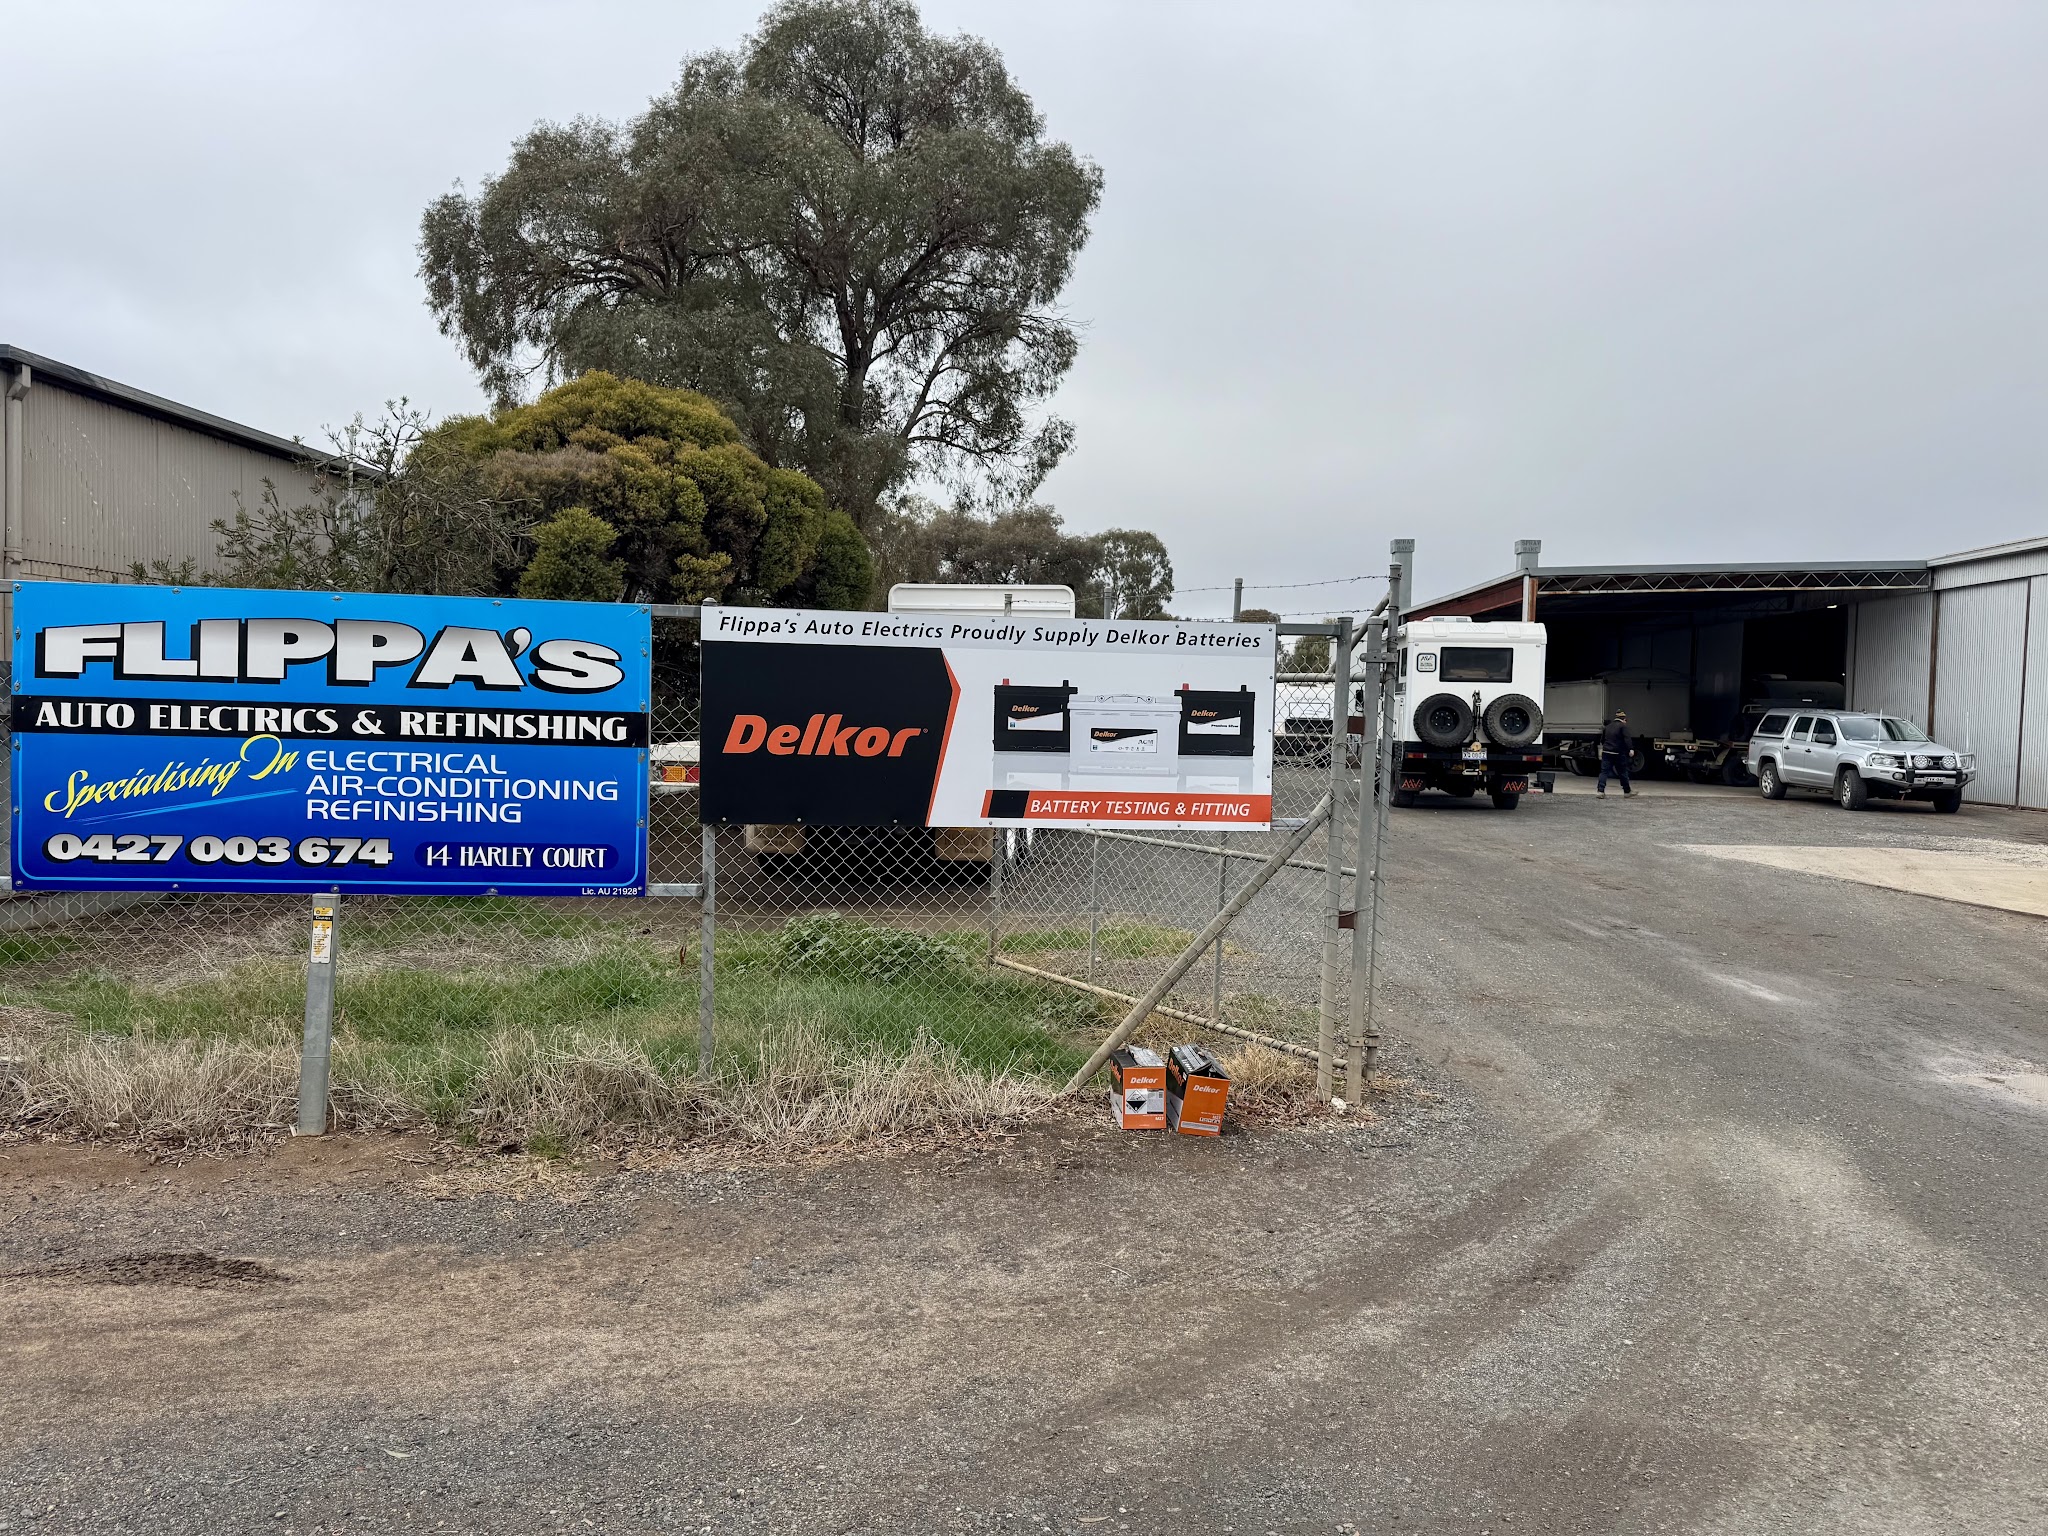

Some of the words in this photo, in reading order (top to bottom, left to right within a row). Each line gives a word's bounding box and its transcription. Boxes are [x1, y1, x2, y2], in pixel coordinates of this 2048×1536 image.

[720, 614, 798, 637] Flippa's
[804, 619, 854, 636] Auto
[861, 620, 944, 639] Electrics
[950, 624, 1027, 645] Proudly
[1032, 626, 1100, 647] Supply
[1106, 629, 1170, 645] Delkor
[1175, 631, 1261, 648] Batteries
[1011, 704, 1039, 713] Delkor
[1190, 709, 1218, 718] Delkor
[35, 702, 135, 729] AUTO
[150, 704, 339, 735] ELECTRICS
[352, 710, 386, 735] &
[400, 711, 628, 741] REFINISHING
[723, 713, 921, 757] Delkor
[306, 750, 507, 776] ELECTRICAL
[44, 752, 241, 818] Specialising
[306, 776, 618, 801] AIR-CONDITIONING
[307, 800, 522, 823] REFINISHING
[1030, 799, 1102, 814] BATTERY
[1105, 801, 1171, 815] TESTING
[1174, 802, 1187, 815] &
[1190, 803, 1251, 817] FITTING
[46, 833, 184, 863] 0427
[189, 836, 291, 863] 003
[298, 837, 393, 865] 674
[427, 844, 453, 866] 14
[460, 846, 535, 867] HARLEY
[542, 848, 608, 868] COURT
[582, 887, 596, 895] Lic.
[598, 887, 611, 895] AU
[612, 887, 638, 895] 21928
[1130, 1076, 1158, 1084] Delkor
[1192, 1084, 1221, 1094] Delkor
